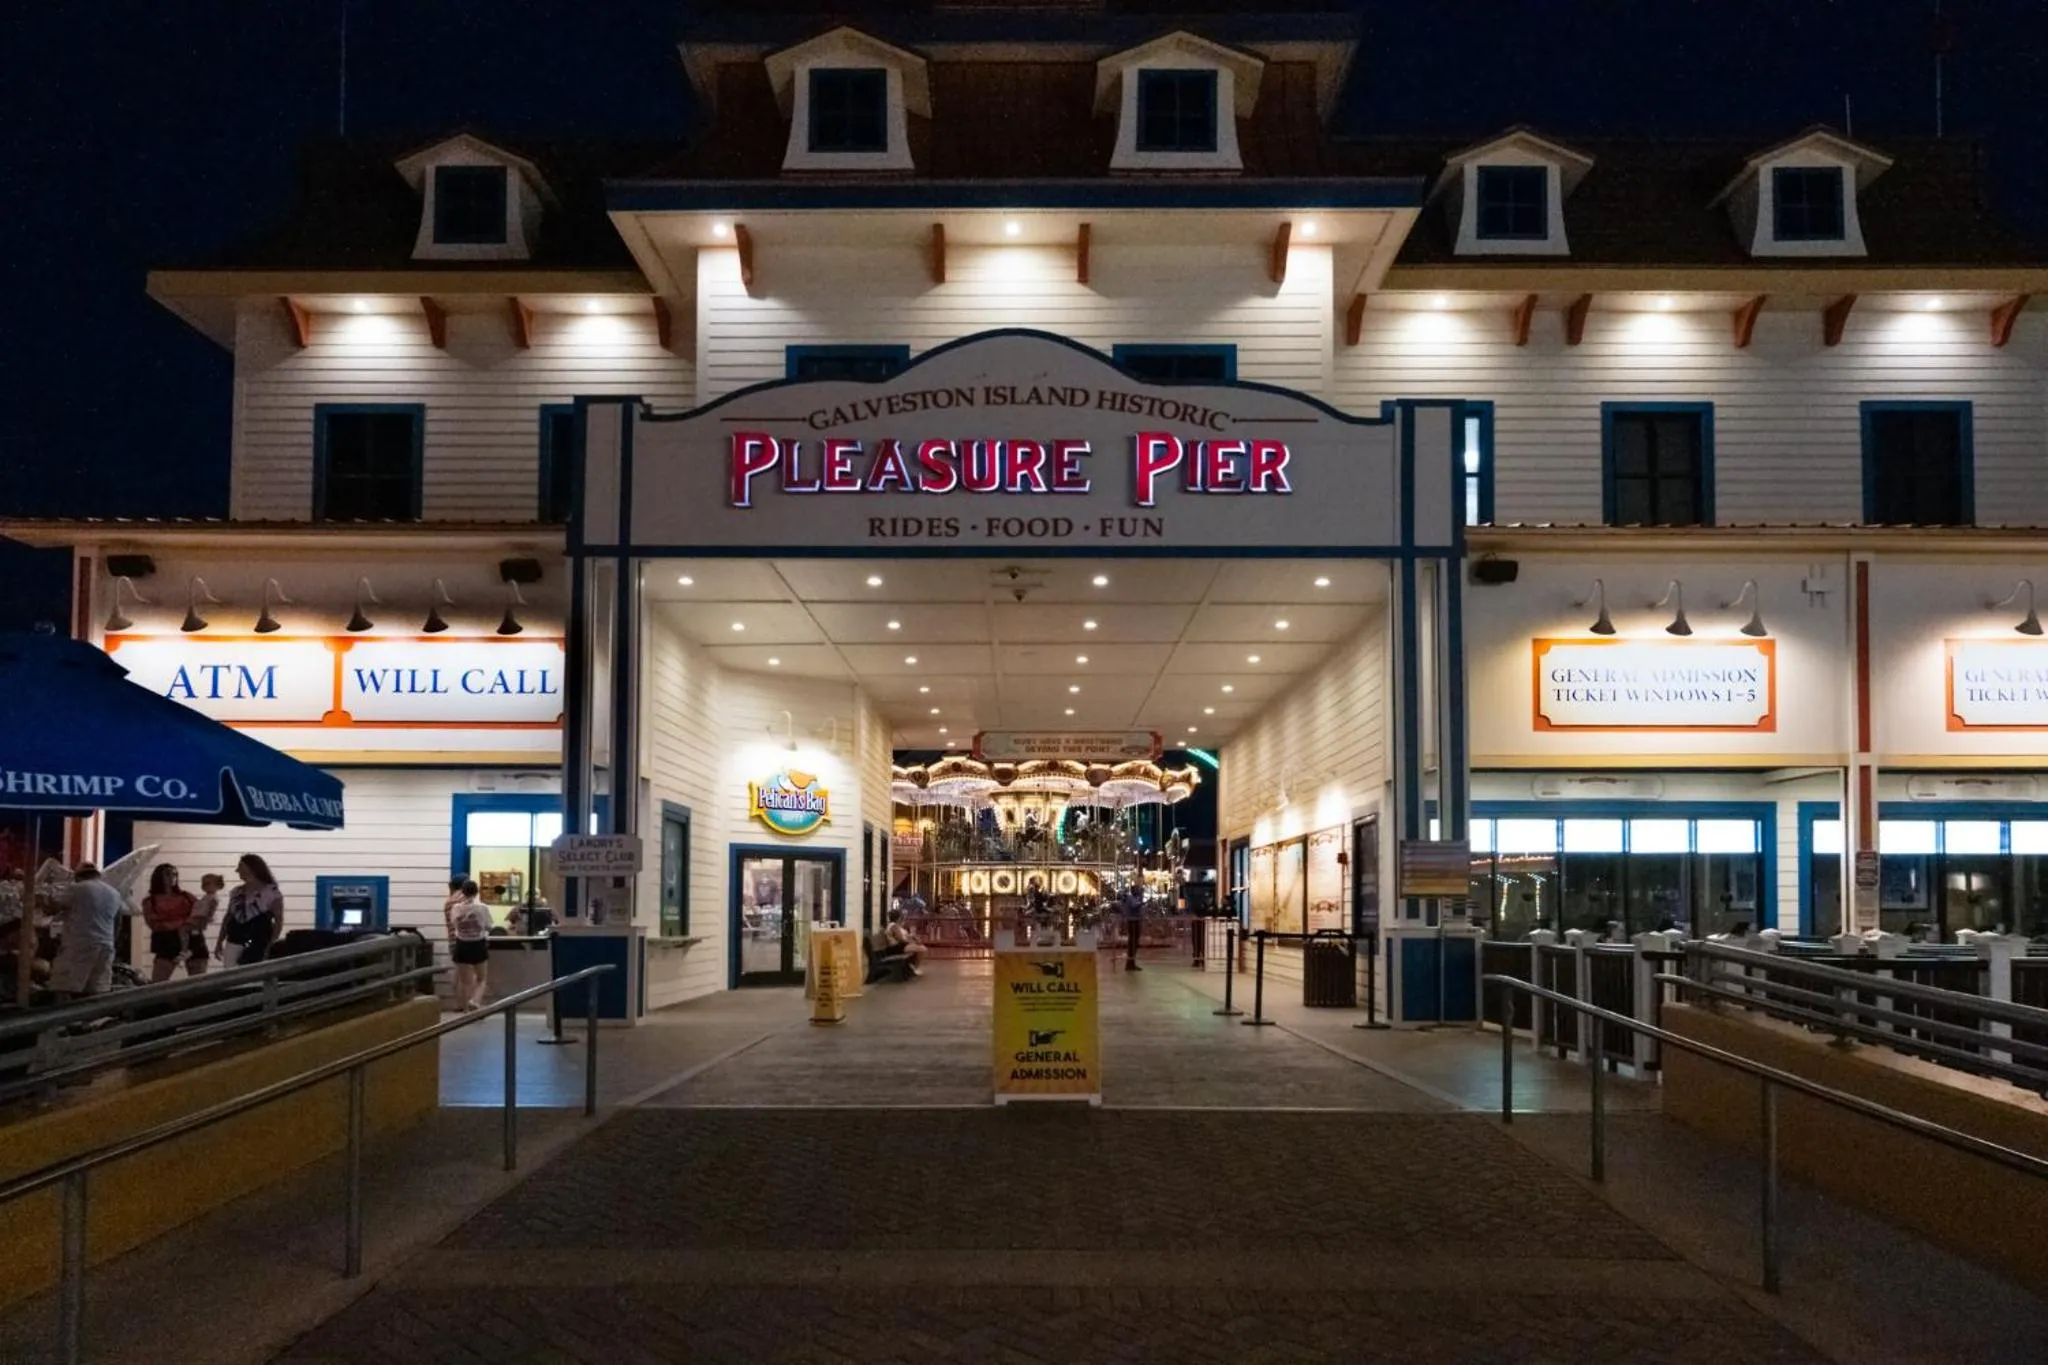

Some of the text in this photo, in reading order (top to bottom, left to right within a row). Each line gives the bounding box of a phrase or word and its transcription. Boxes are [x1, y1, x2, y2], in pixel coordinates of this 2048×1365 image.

[808, 386, 1230, 432] GALVESTON ISLAND HISTORIC
[731, 431, 1293, 508] PLEASURE PIER
[867, 517, 1165, 537] RIDES FOOD FUN
[165, 664, 279, 700] ATM
[353, 668, 558, 694] WILL CALL
[1551, 668, 1757, 683] GENERAL ADMISSION
[1552, 689, 1618, 702] TICKET
[1626, 689, 1720, 702] WINDOWS
[0, 765, 124, 796] HRIMP
[247, 786, 304, 812] BUBBA
[758, 787, 826, 815] Pelican's Bay
[558, 850, 635, 864] SELECT CLUB
[1011, 981, 1082, 993] WILL CALL
[1015, 1050, 1080, 1062] GENERAL
[1010, 1067, 1088, 1081] ADMISSION
